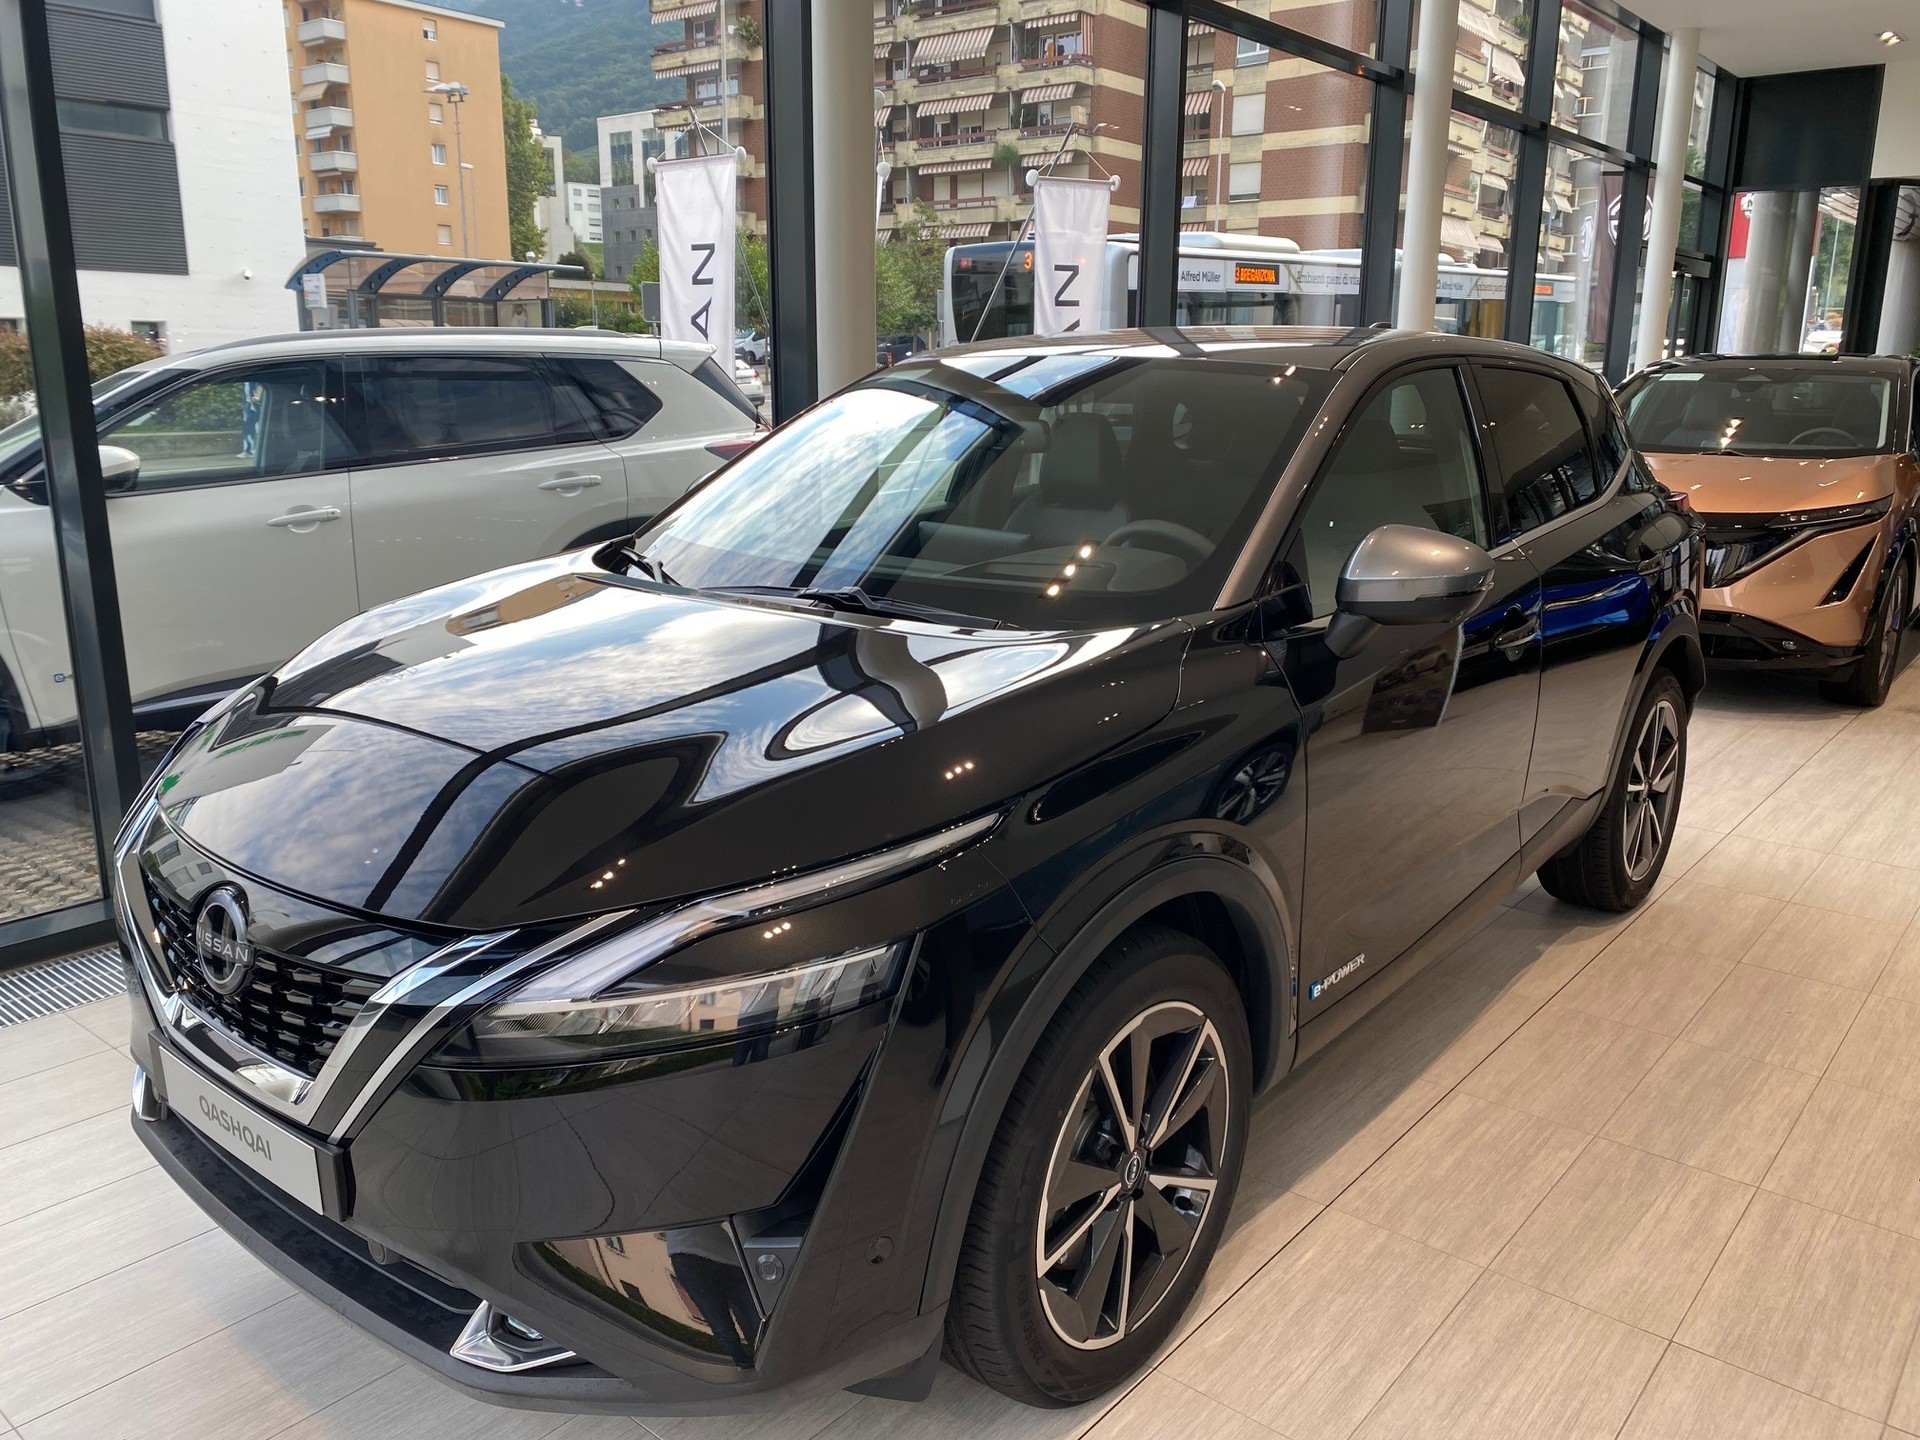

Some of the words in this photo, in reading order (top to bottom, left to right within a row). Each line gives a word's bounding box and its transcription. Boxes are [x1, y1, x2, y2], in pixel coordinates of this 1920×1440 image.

[1024, 252, 1033, 269] 3
[1181, 270, 1200, 282] Alfred
[1201, 271, 1221, 283] Müller
[1313, 953, 1366, 998] e-POWER
[199, 1095, 272, 1161] QASHQAI
